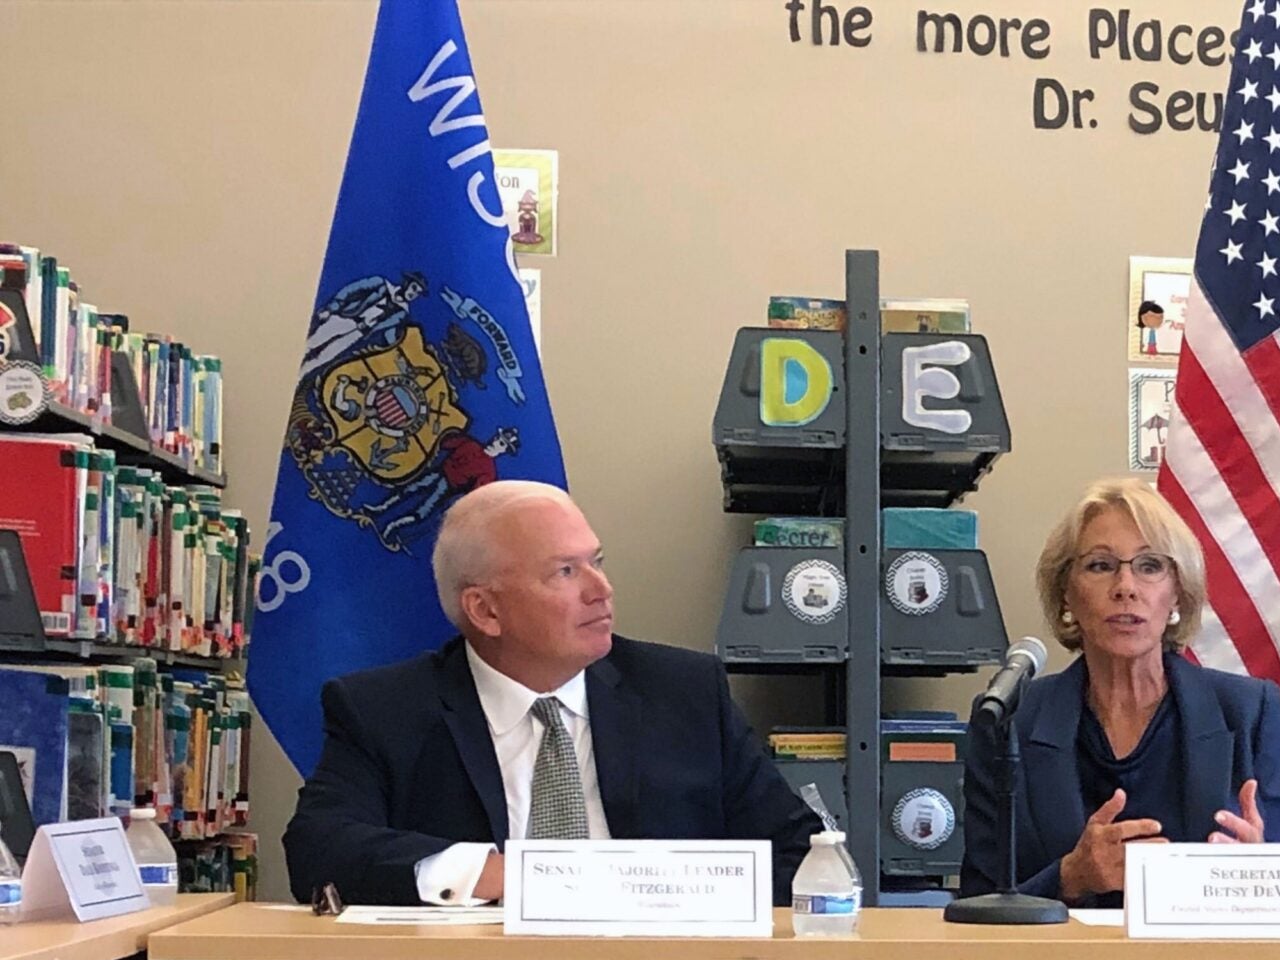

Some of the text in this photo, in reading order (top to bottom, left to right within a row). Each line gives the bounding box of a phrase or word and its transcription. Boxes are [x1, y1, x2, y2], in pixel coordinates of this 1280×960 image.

[786, 0, 873, 48] the
[916, 9, 1051, 60] more
[1033, 78, 1098, 130] Dr.
[497, 173, 520, 189] on
[469, 305, 517, 372] FORWARD
[760, 338, 834, 427] D
[902, 340, 972, 434] E
